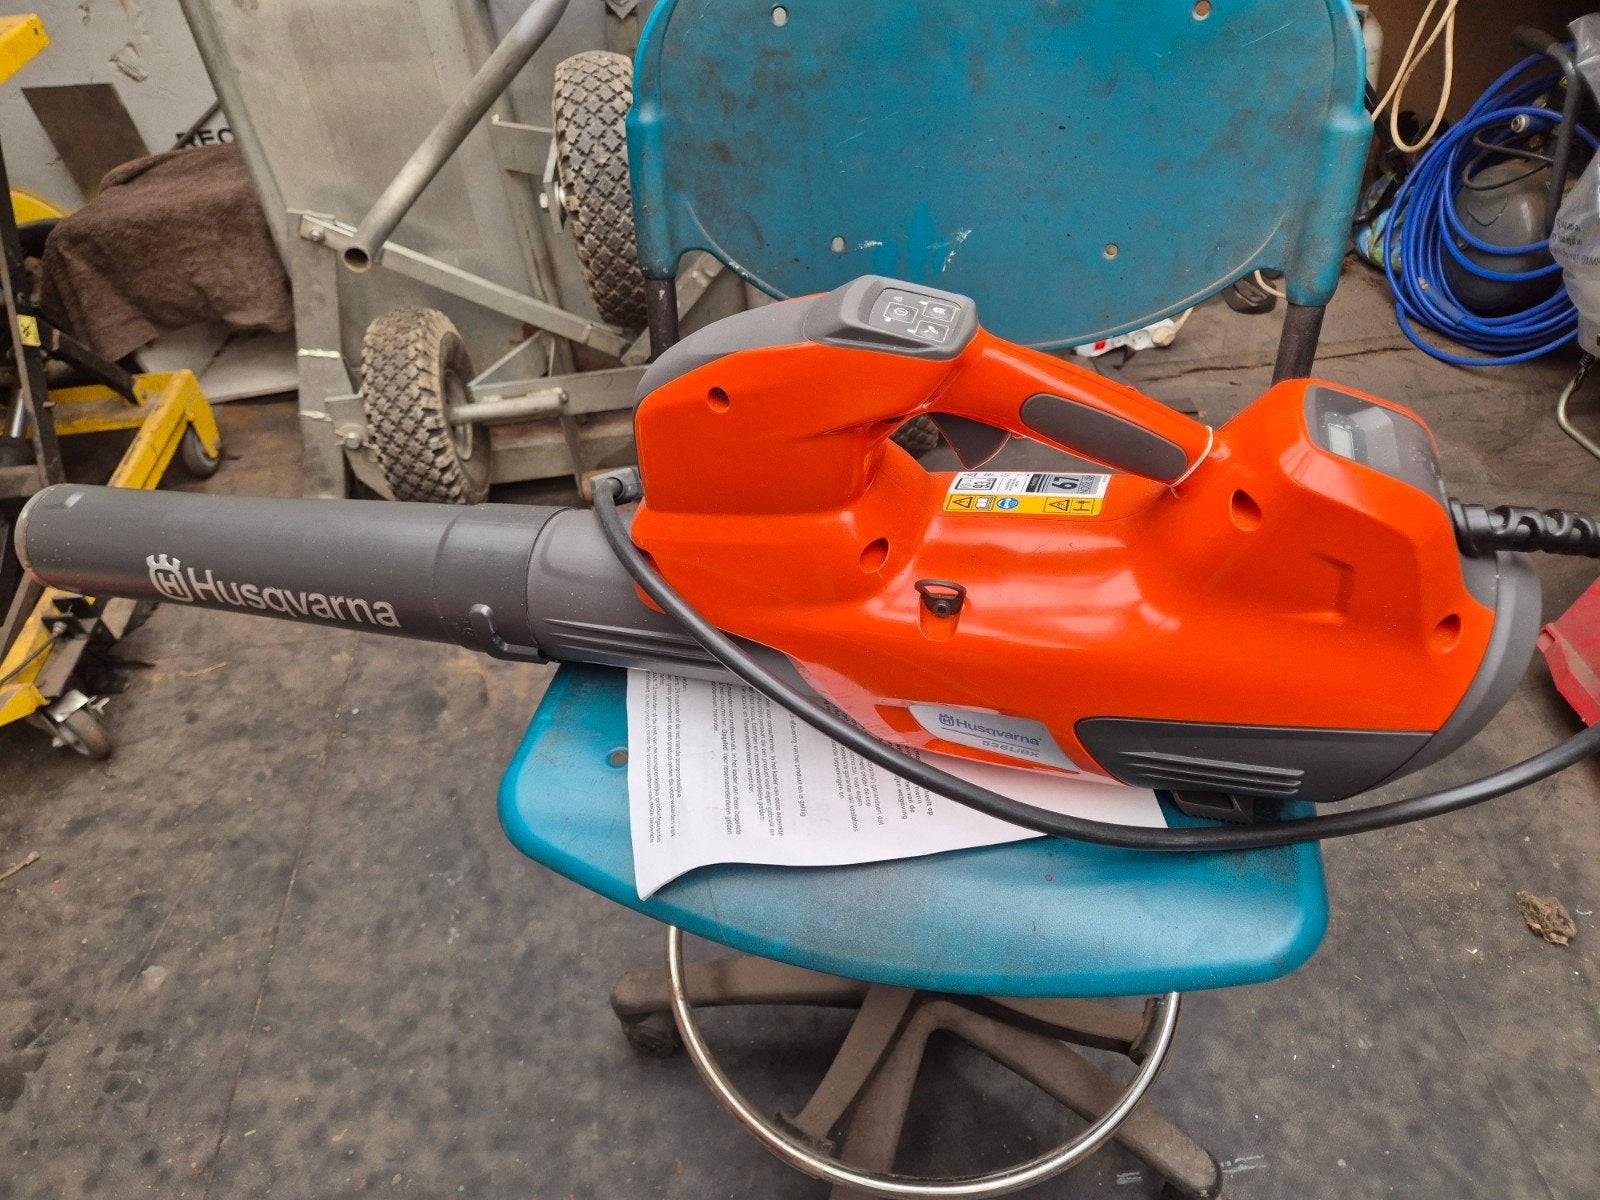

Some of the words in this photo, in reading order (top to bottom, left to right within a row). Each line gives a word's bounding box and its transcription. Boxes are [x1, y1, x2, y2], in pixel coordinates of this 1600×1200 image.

[1051, 476, 1079, 490] 67
[187, 567, 401, 627] Husqvarna
[956, 718, 1040, 746] Husqvarna
[760, 758, 770, 777] product
[770, 761, 778, 770] het
[771, 771, 779, 785] kader
[792, 764, 803, 784] product
[860, 771, 868, 786] onder
[763, 790, 772, 806] eigen
[773, 797, 781, 810] deze
[853, 790, 863, 806] eigen
[863, 796, 871, 806] kop
[894, 788, 908, 819] wetgeving
[796, 800, 806, 816] geldig
[774, 811, 784, 836] beperkte
[876, 815, 884, 825] dat
